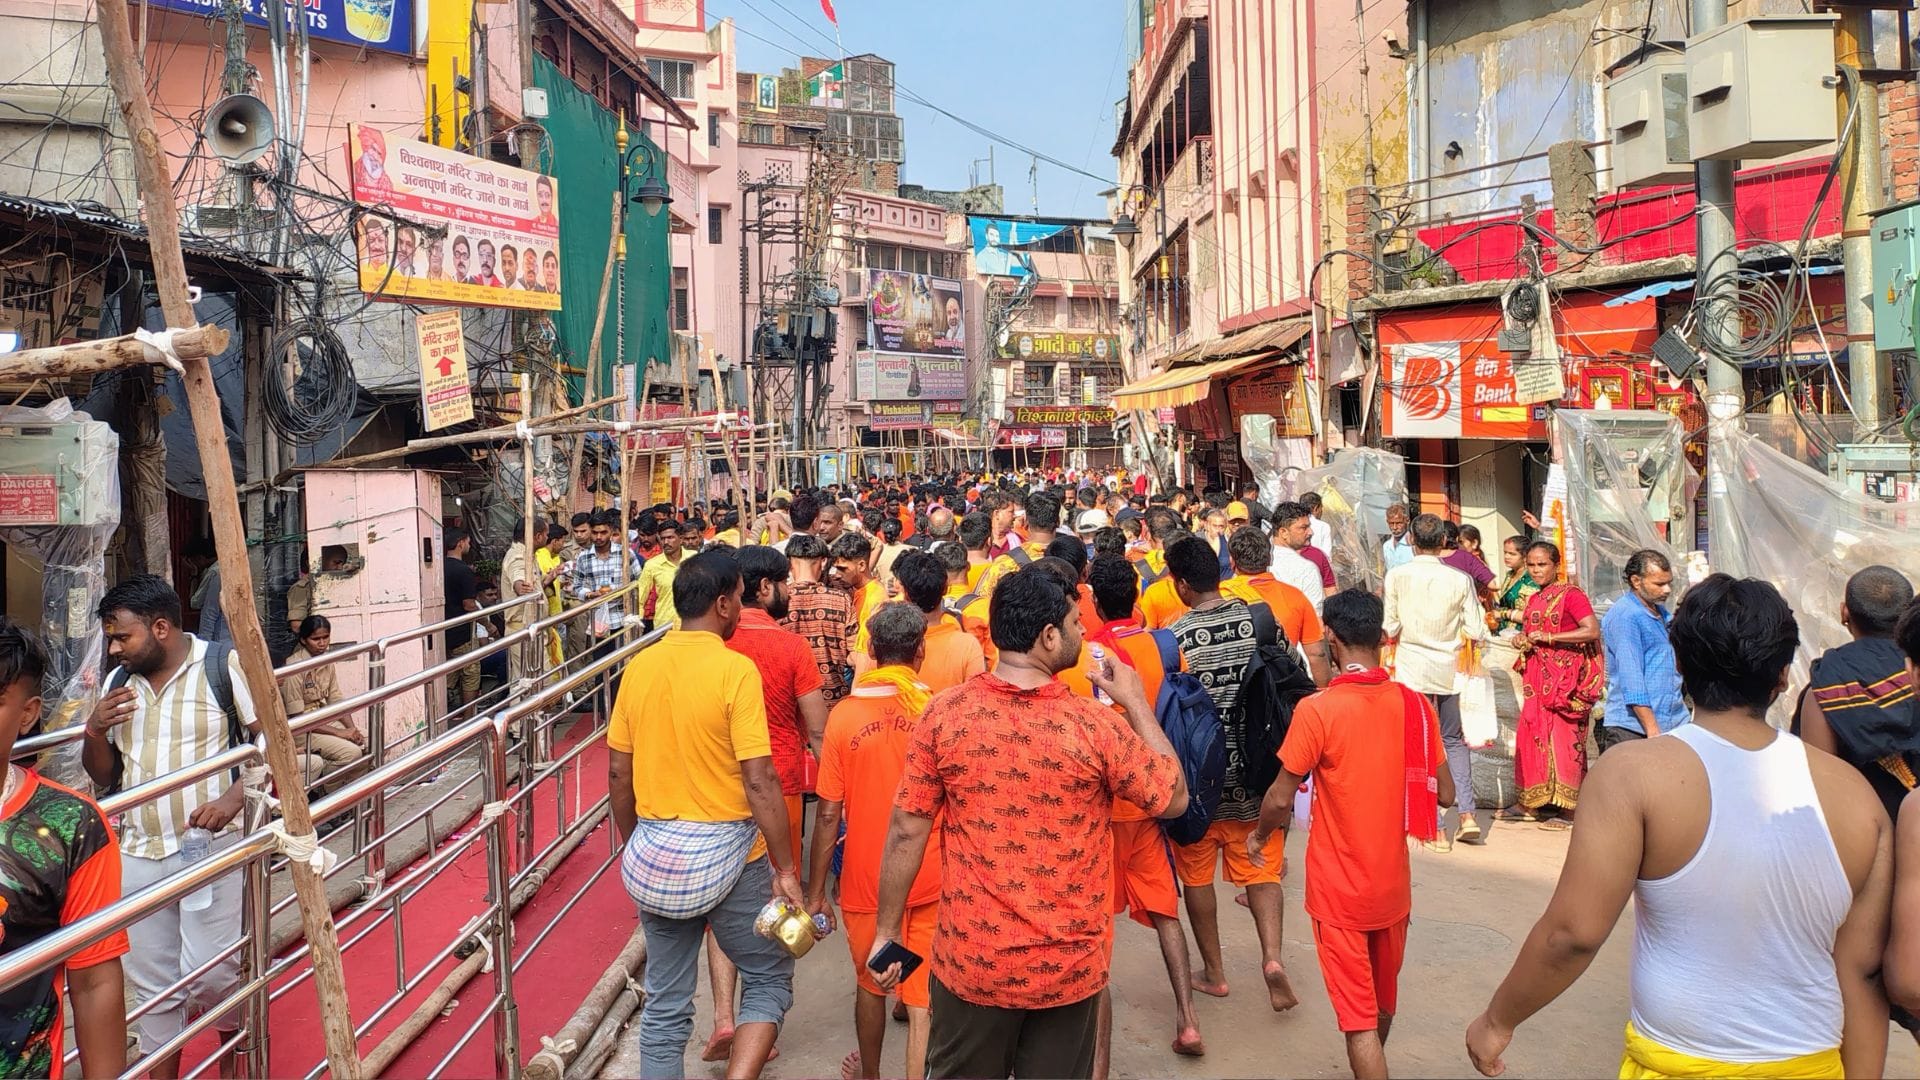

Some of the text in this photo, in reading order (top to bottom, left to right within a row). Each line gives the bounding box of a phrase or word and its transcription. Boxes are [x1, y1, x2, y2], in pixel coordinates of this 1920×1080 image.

[400, 148, 528, 194] विश्वनाथ मंदिर जाने का मार्ग
[402, 172, 529, 212] अन्नपूर्णा मंदिर जाने का मार्ग
[469, 226, 490, 239] आपका
[422, 328, 460, 346] मंदिर जाने
[1034, 333, 1064, 354] शादी
[430, 343, 459, 358] का मार्ग
[1474, 355, 1500, 379] बैंक
[1474, 383, 1513, 404] Bank
[1016, 406, 1075, 424] विश्वनाथ
[1, 479, 52, 489] DANGER
[861, 720, 884, 738] नमः
[894, 715, 916, 733] शि
